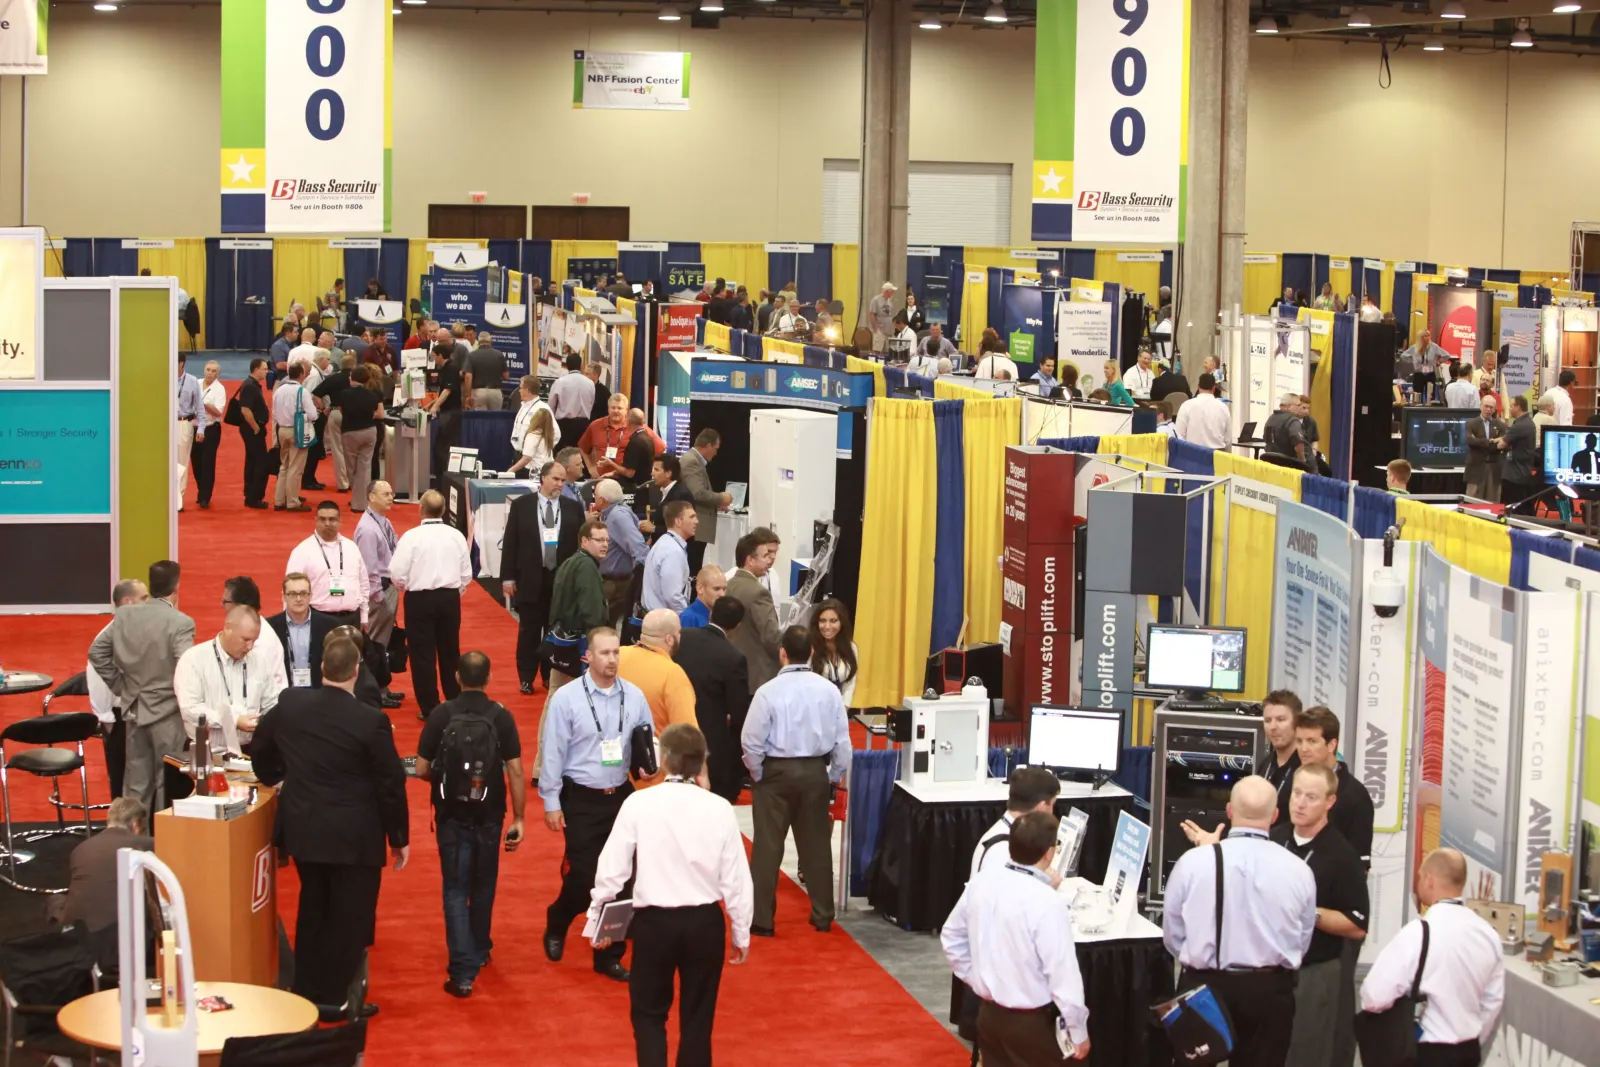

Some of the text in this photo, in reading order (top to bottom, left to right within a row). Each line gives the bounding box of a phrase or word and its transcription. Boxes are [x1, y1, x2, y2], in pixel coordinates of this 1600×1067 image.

[588, 74, 680, 85] NRF Fusion Center
[298, 179, 326, 193] Bass
[327, 179, 378, 194] Security
[1102, 192, 1127, 205] Bass
[1128, 192, 1173, 208] Security
[669, 275, 704, 286] SAFE
[451, 293, 468, 301] who
[511, 360, 524, 368] loss
[790, 378, 818, 390] AMSEC
[17, 428, 56, 439] Stronger
[60, 428, 98, 439] Security
